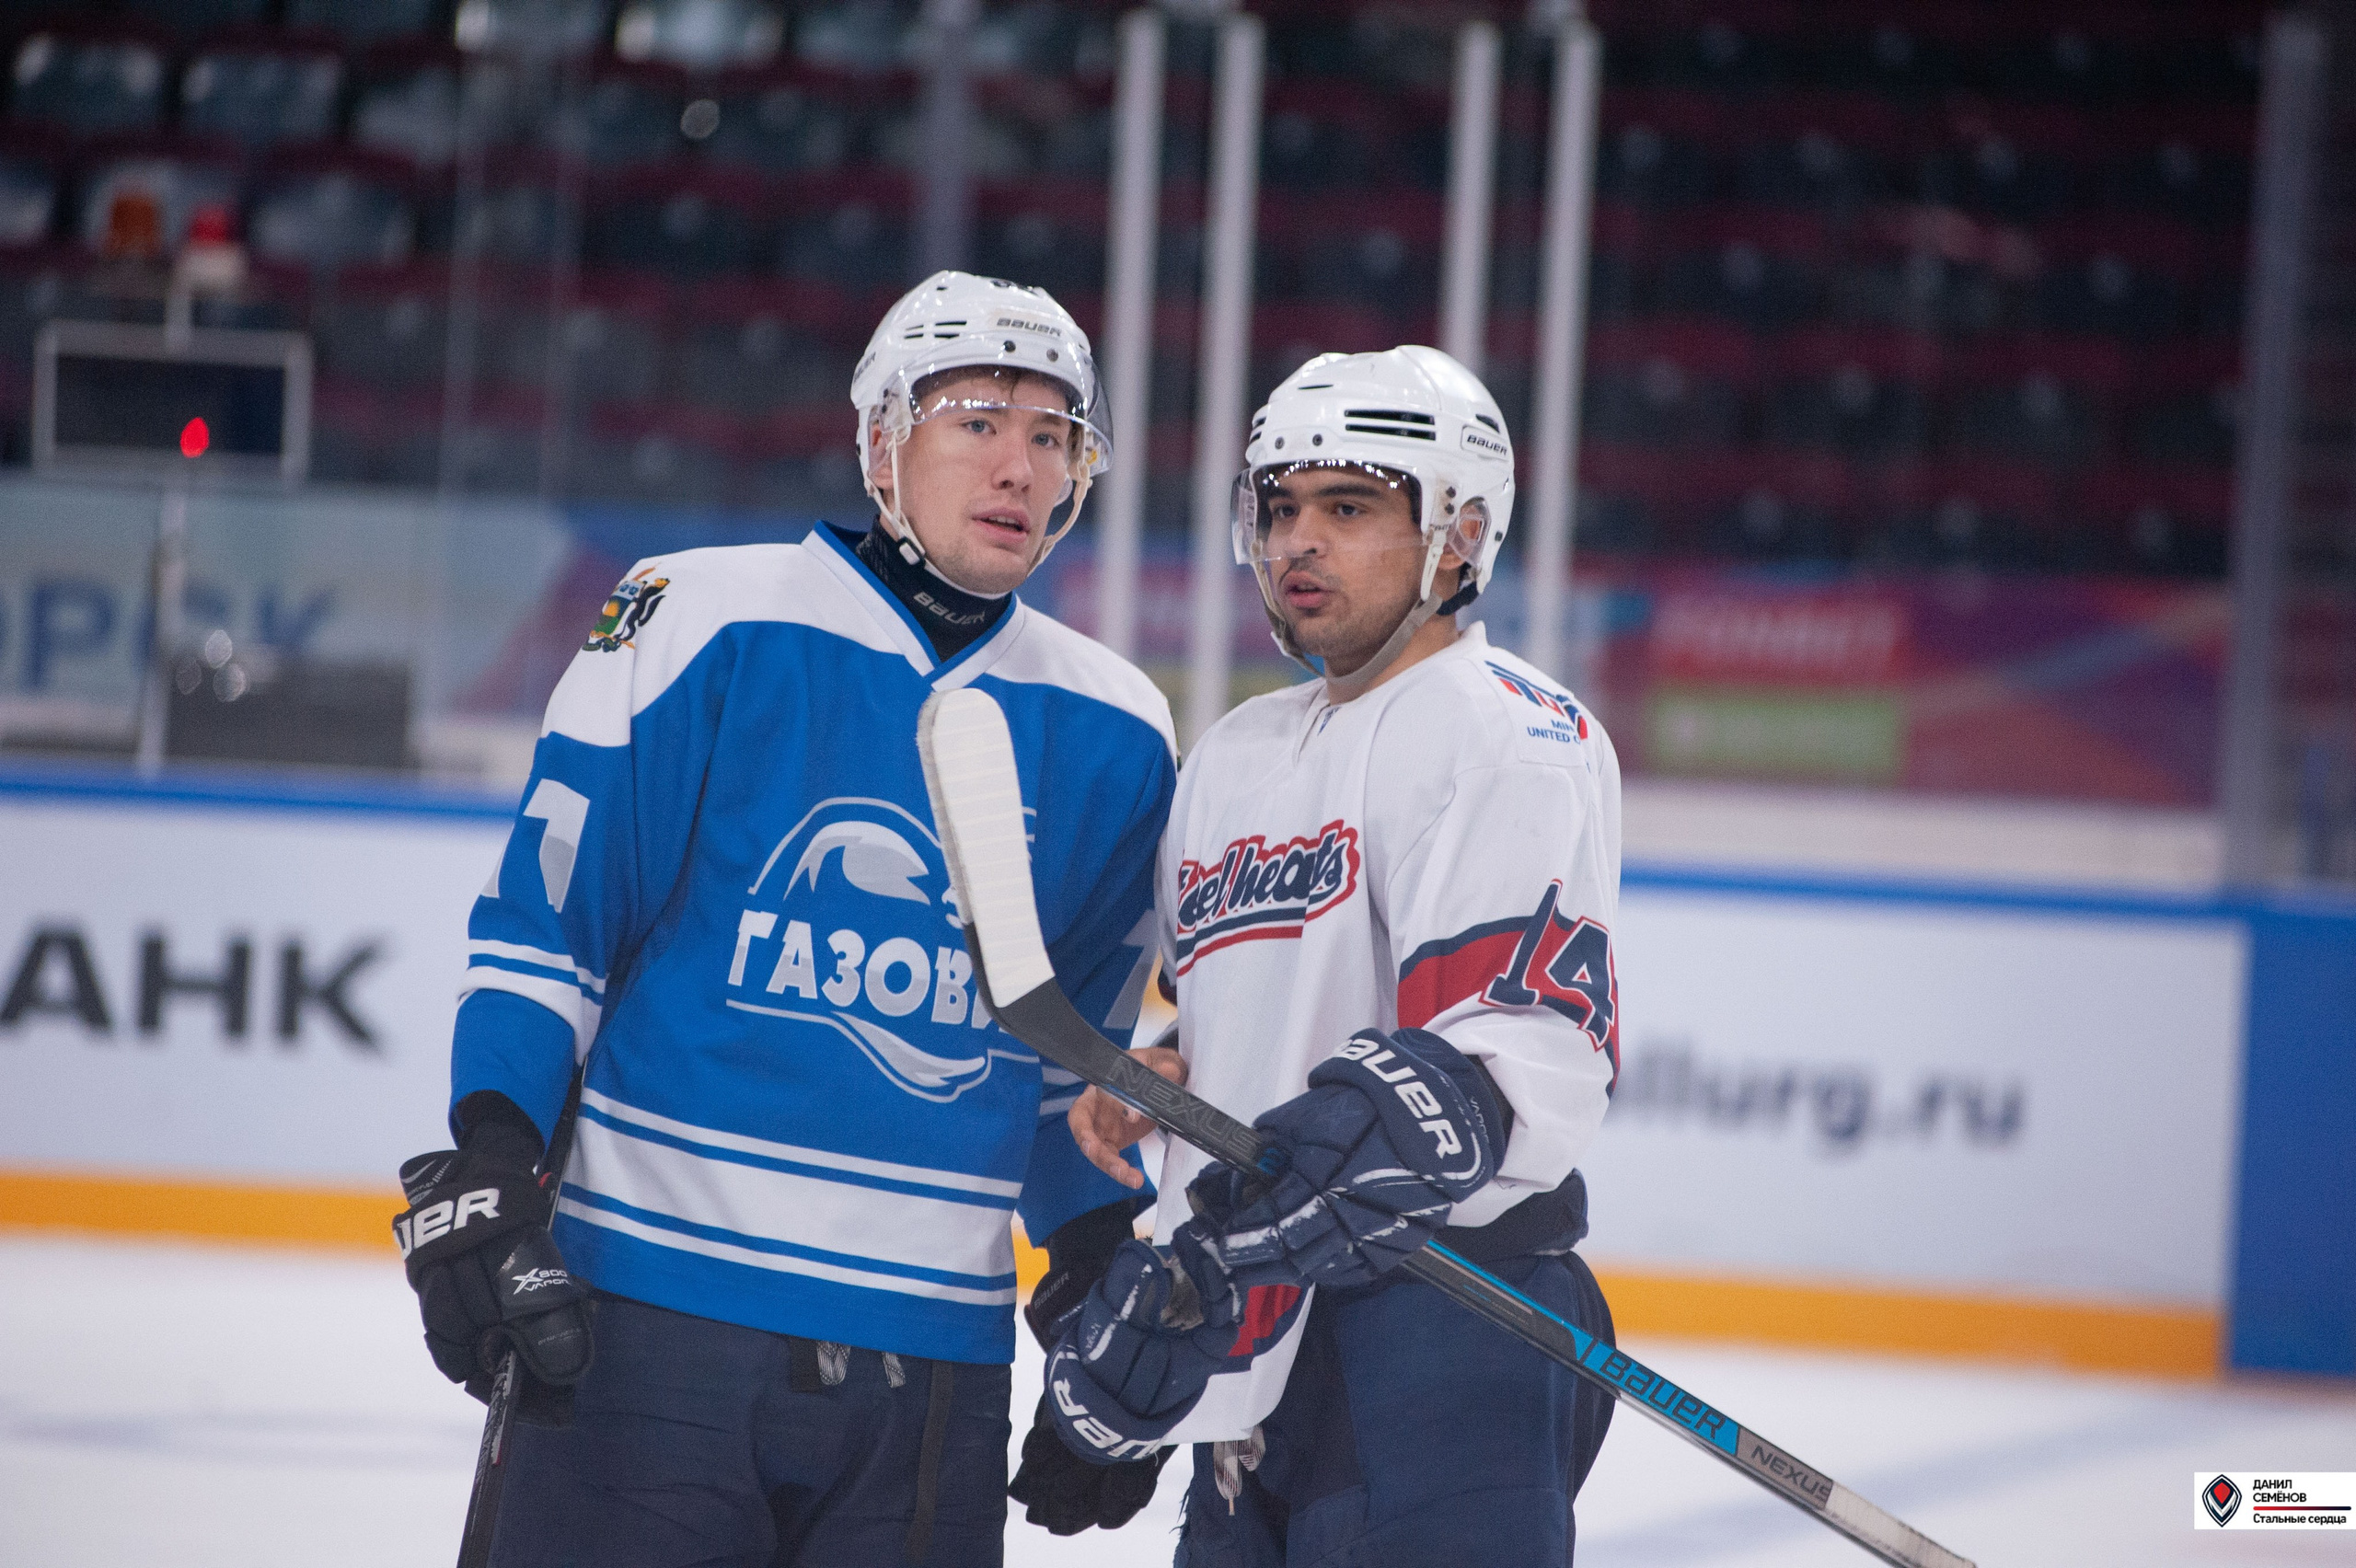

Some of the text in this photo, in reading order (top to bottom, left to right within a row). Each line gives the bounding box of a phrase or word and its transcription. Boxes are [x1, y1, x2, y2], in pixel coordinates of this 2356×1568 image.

[997, 317, 1062, 337] BAUER
[1467, 434, 1507, 456] BAUER
[1527, 726, 1570, 743] UNITED
[1481, 880, 1617, 1050] 14
[1107, 1055, 1263, 1169] NEXUS
[1334, 1037, 1463, 1160] AUER
[1053, 1378, 1158, 1459] UER
[1600, 1351, 1727, 1440] BAUER
[1750, 1446, 1831, 1504] NEXUS
